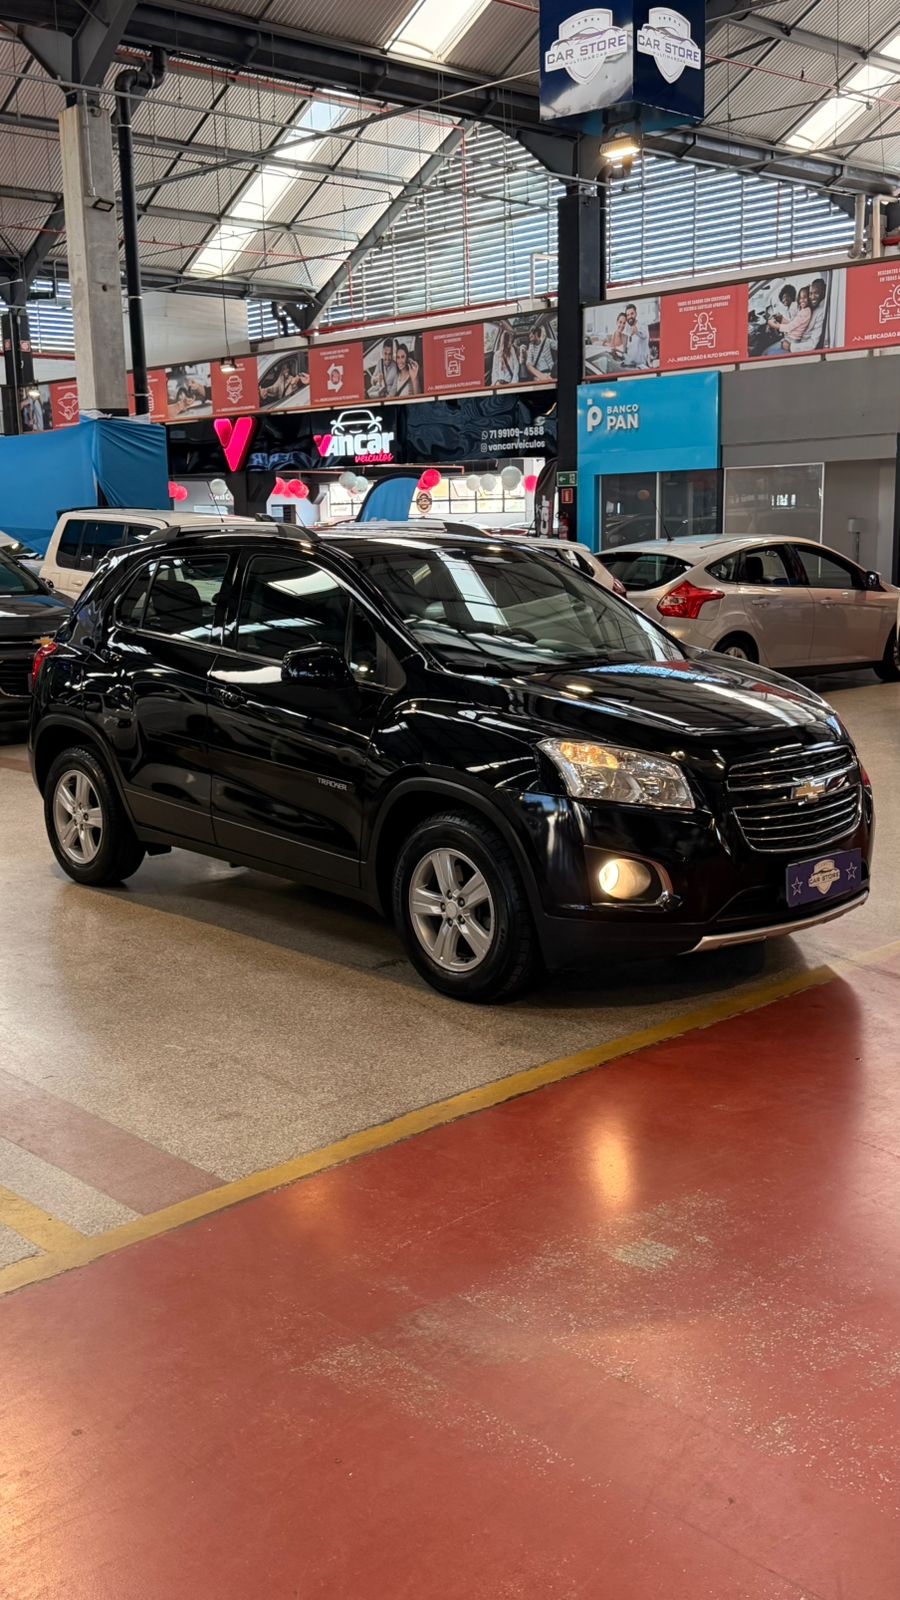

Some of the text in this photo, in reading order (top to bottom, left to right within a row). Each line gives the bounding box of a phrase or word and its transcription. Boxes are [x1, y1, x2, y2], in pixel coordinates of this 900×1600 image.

[547, 34, 626, 64] CAR STORE
[638, 35, 699, 62] CAR STORE
[607, 404, 639, 414] BANCO
[607, 413, 639, 430] PAN
[489, 426, 544, 439] 71 99109-4588
